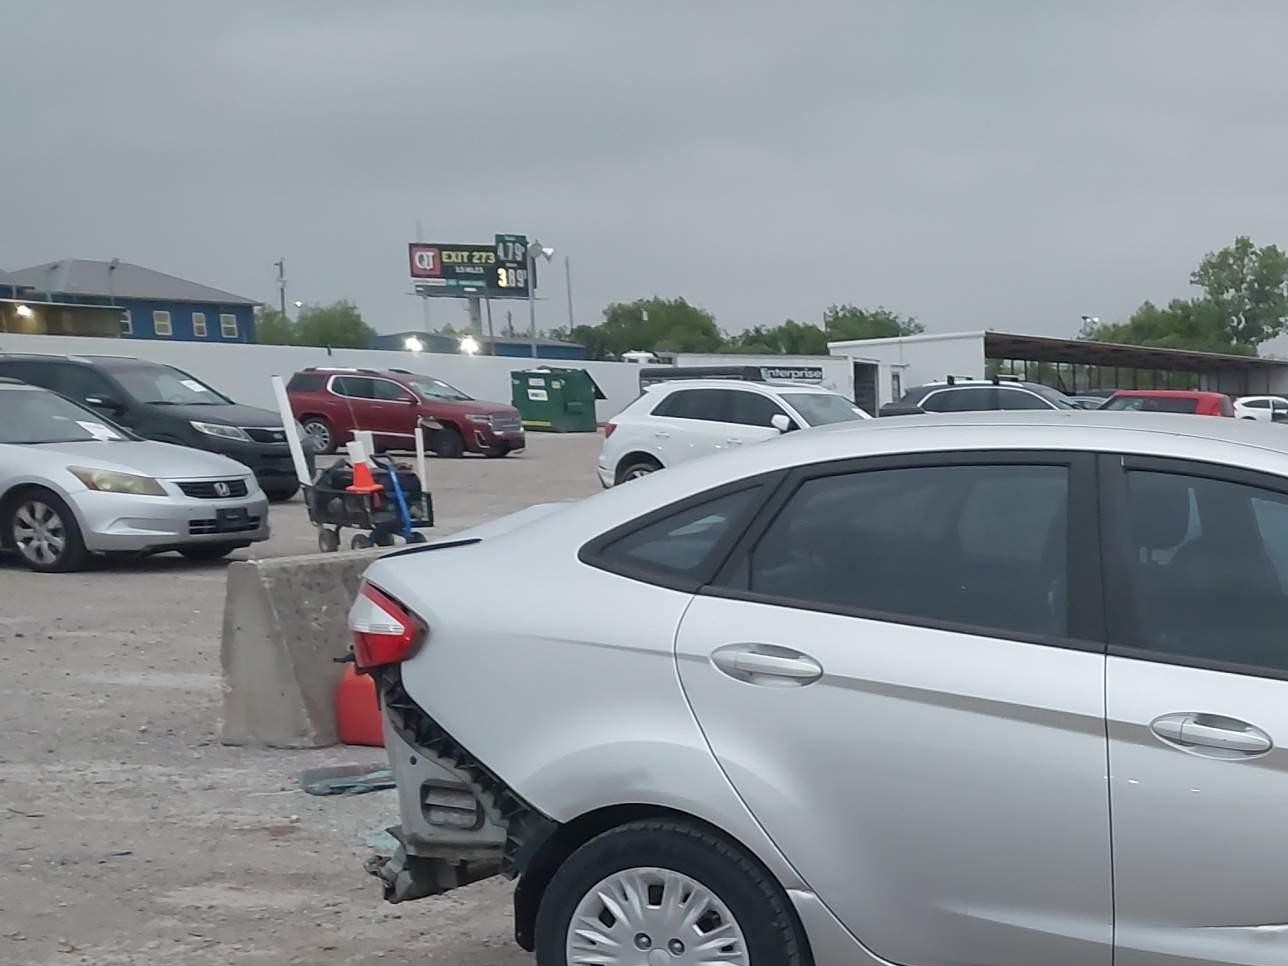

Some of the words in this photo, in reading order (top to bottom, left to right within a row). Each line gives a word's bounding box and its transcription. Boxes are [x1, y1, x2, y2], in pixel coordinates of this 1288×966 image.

[415, 251, 435, 270] QT
[441, 251, 469, 263] EXIT
[472, 251, 496, 264] 273
[761, 367, 822, 380] Enterprise
